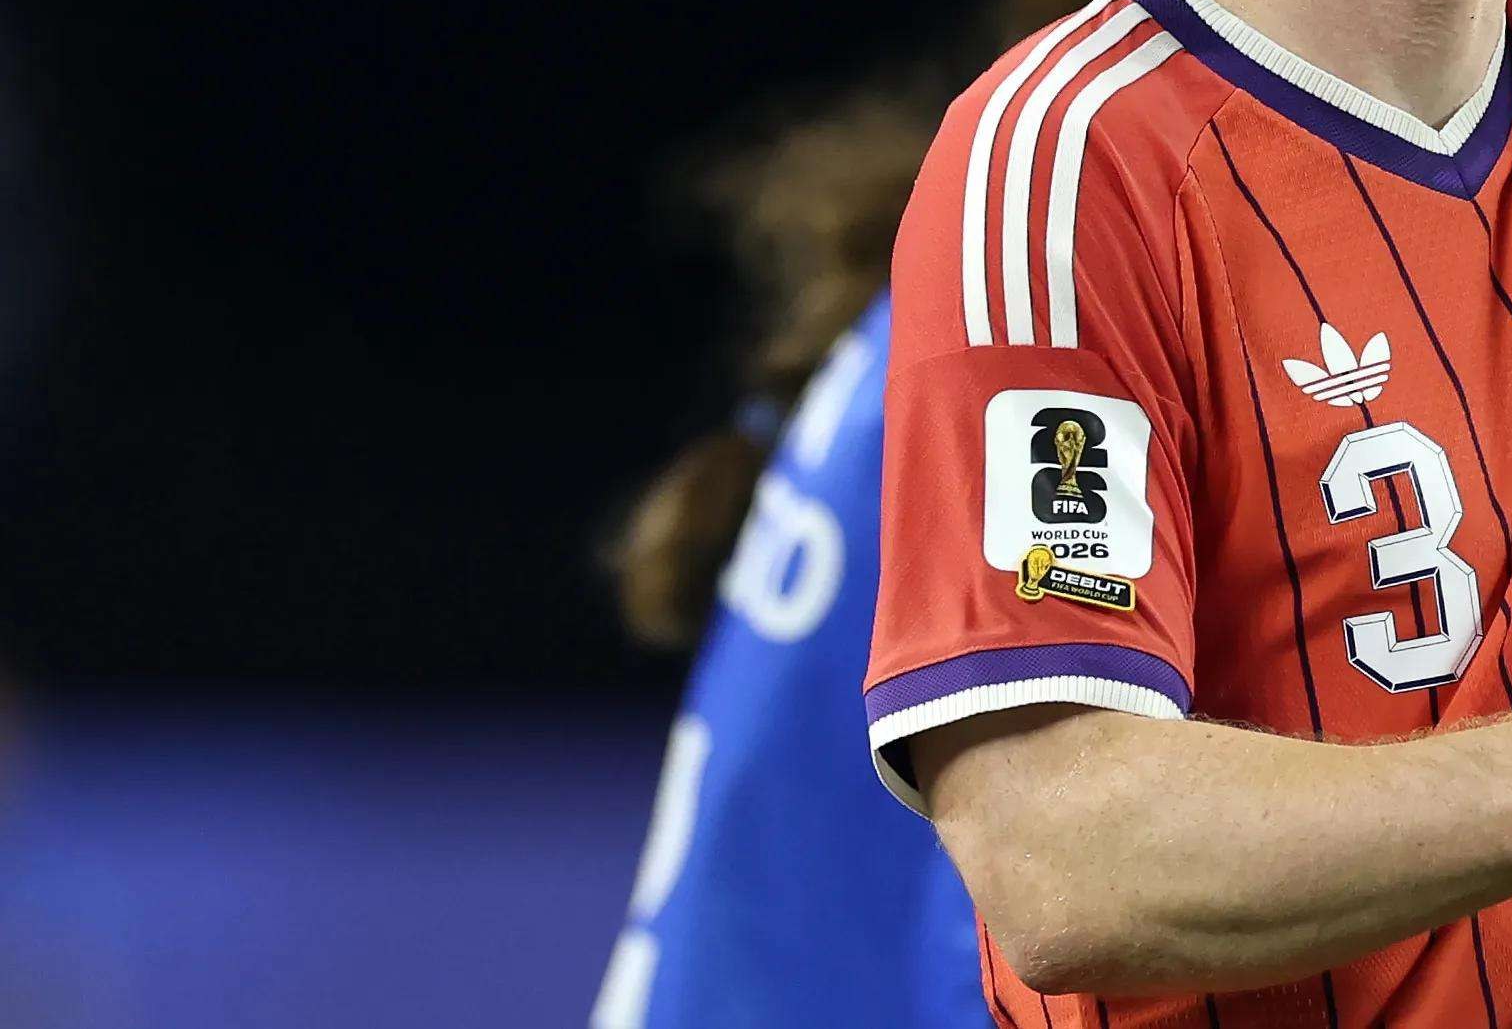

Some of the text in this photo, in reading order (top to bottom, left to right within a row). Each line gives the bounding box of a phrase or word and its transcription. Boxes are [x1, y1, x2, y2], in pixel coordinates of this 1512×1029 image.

[1052, 500, 1089, 515] FIFA
[1031, 529, 1109, 541] WORLD CUP
[1031, 543, 1110, 559] 026
[1319, 421, 1483, 693] 3
[1050, 569, 1127, 595] DEBUT
